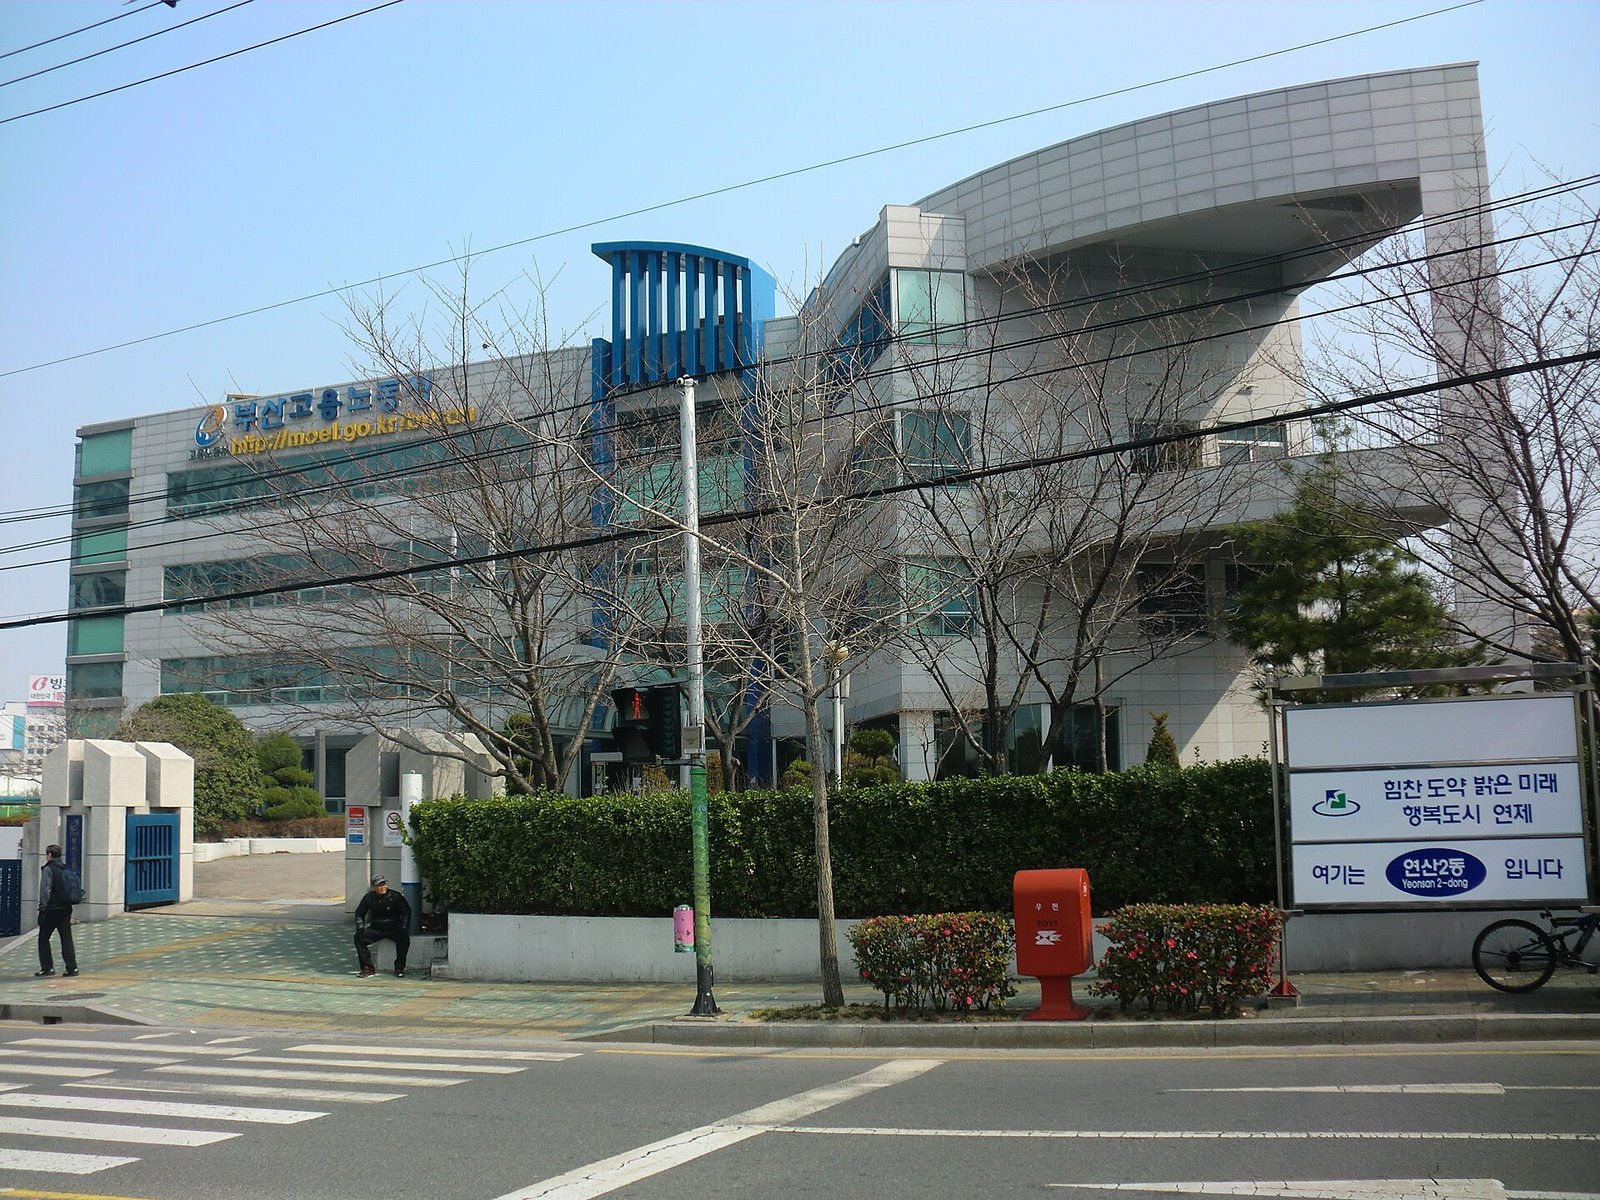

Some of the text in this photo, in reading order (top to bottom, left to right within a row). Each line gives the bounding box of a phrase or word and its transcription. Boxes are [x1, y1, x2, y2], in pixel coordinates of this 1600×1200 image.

[1384, 773, 1558, 800] 힘찬 도약 밝은 미래
[1403, 803, 1533, 827] 행복도시 연제
[1312, 857, 1564, 886] 여기는 연산2동 입니다
[1401, 877, 1469, 889] Yeonsan 2-dong
[1036, 920, 1060, 928] POST
